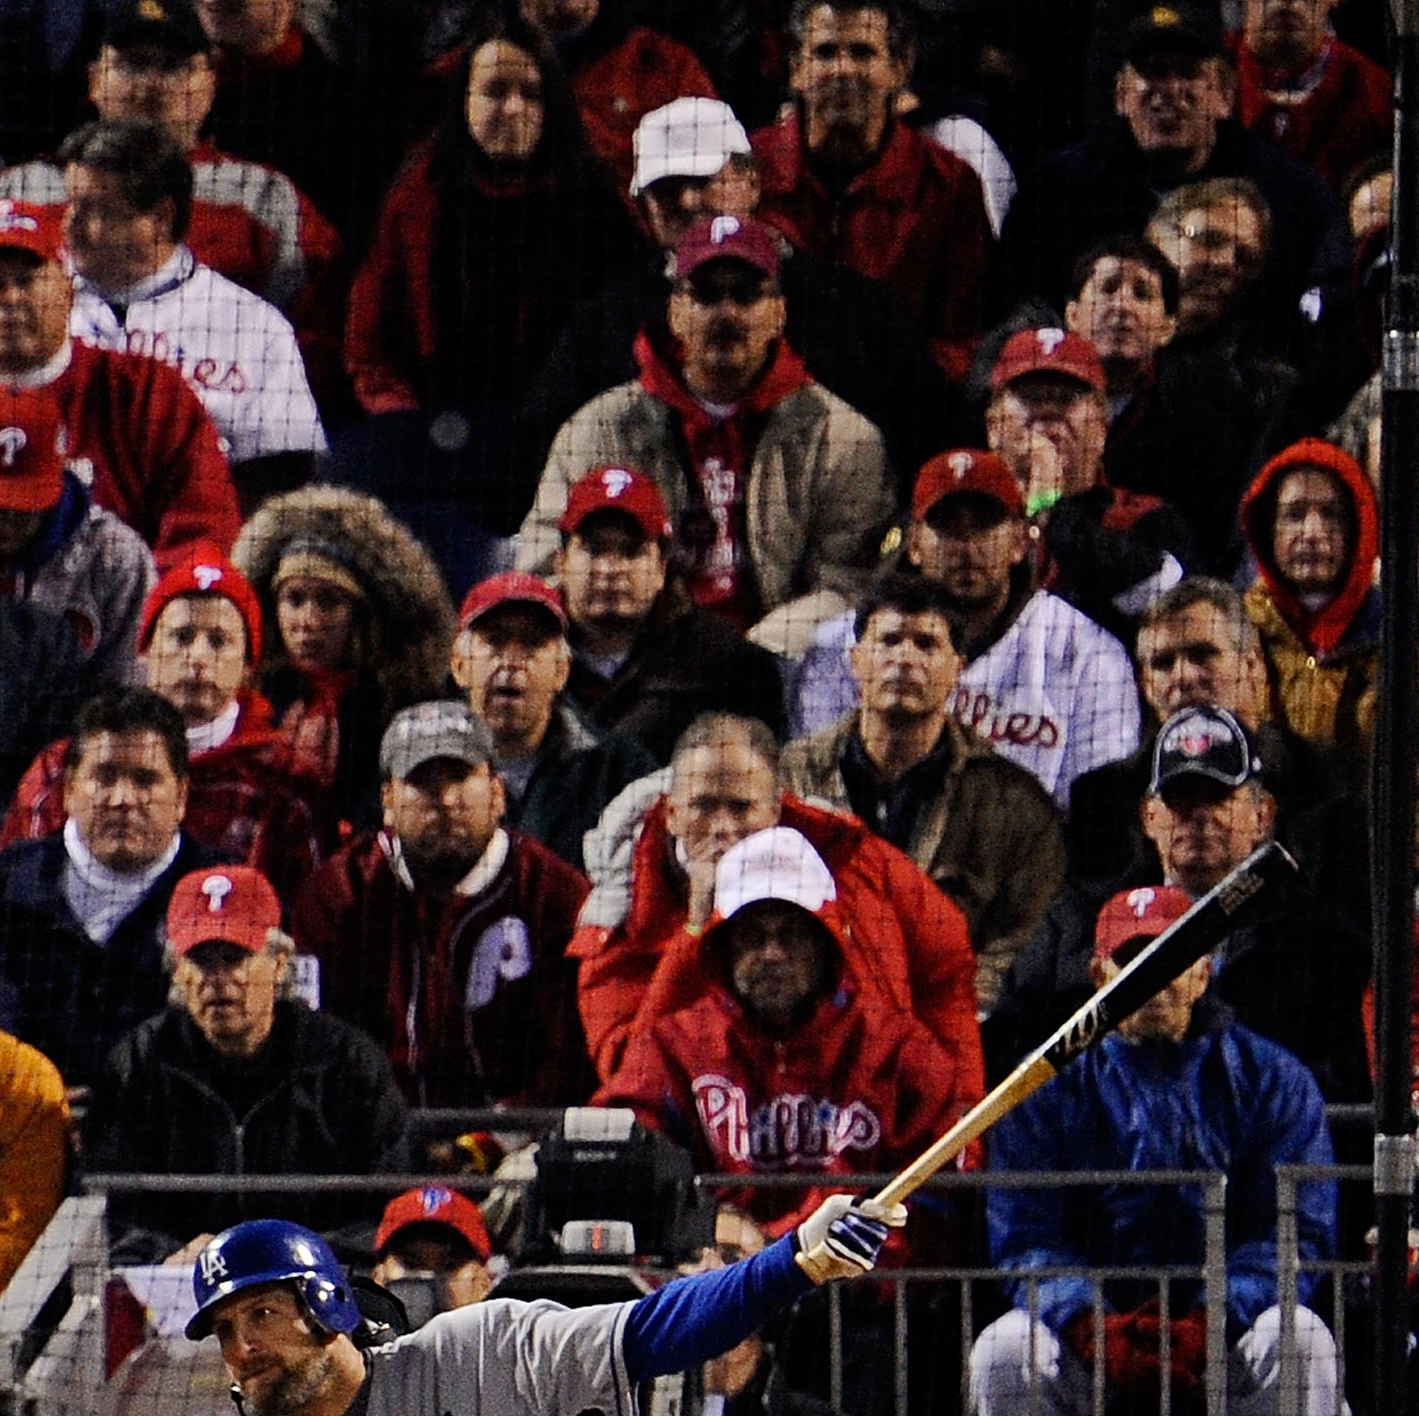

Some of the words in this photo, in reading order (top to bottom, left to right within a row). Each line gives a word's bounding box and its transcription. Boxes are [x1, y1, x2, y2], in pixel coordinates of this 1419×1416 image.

[953, 688, 1059, 749] llies
[465, 913, 534, 1012] P
[199, 1252, 229, 1286] LA
